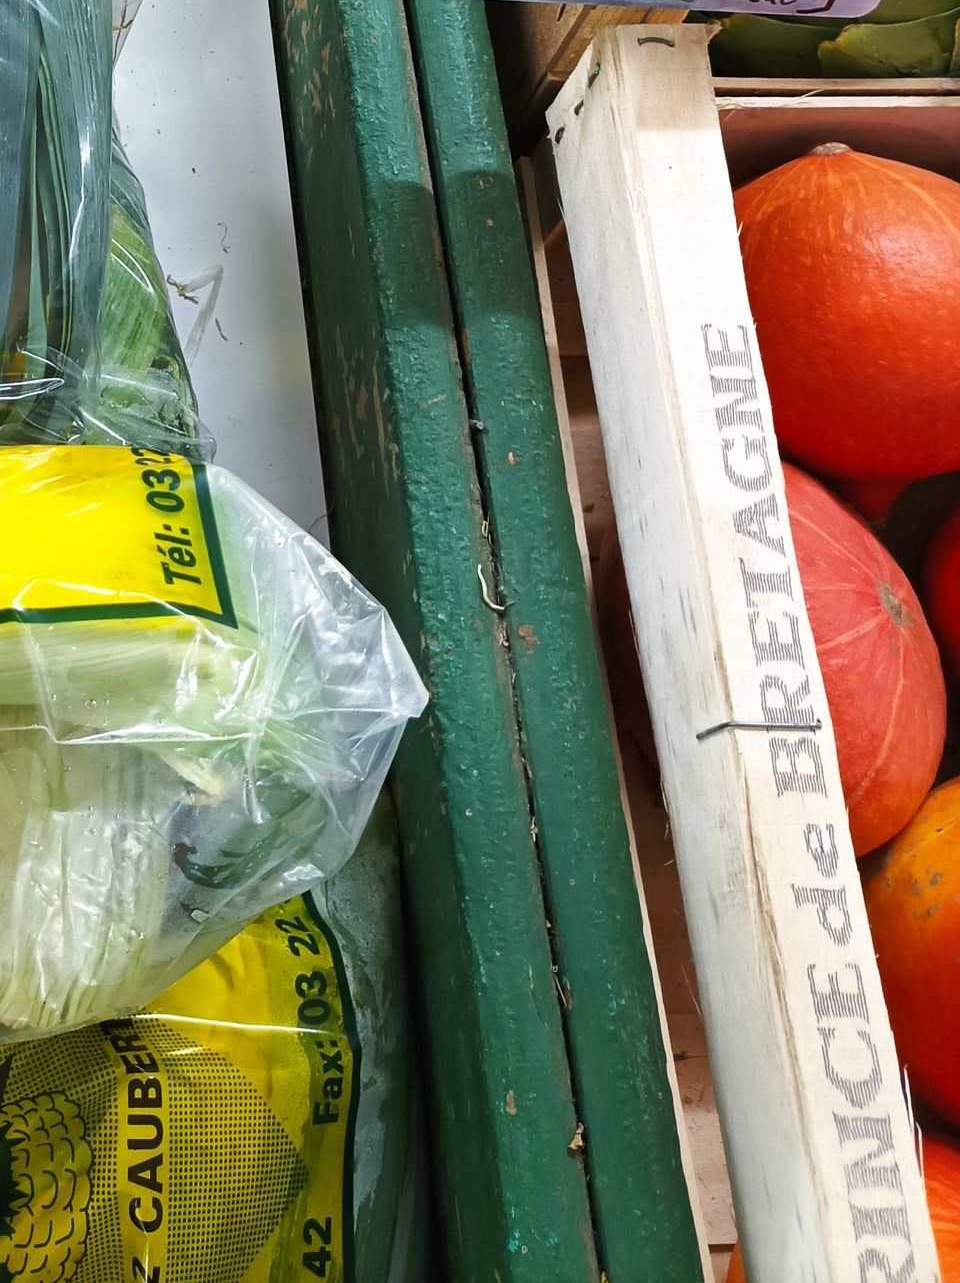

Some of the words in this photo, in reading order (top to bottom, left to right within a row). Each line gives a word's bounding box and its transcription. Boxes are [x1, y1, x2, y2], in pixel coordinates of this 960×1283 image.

[141, 468, 185, 513] 03
[153, 523, 203, 585] Tél:
[701, 321, 830, 798] BRETAGNE
[790, 822, 841, 945] de
[274, 915, 320, 958] 22
[293, 969, 331, 1026] 03
[311, 1037, 346, 1126] Fax:
[301, 1216, 333, 1278] 42
